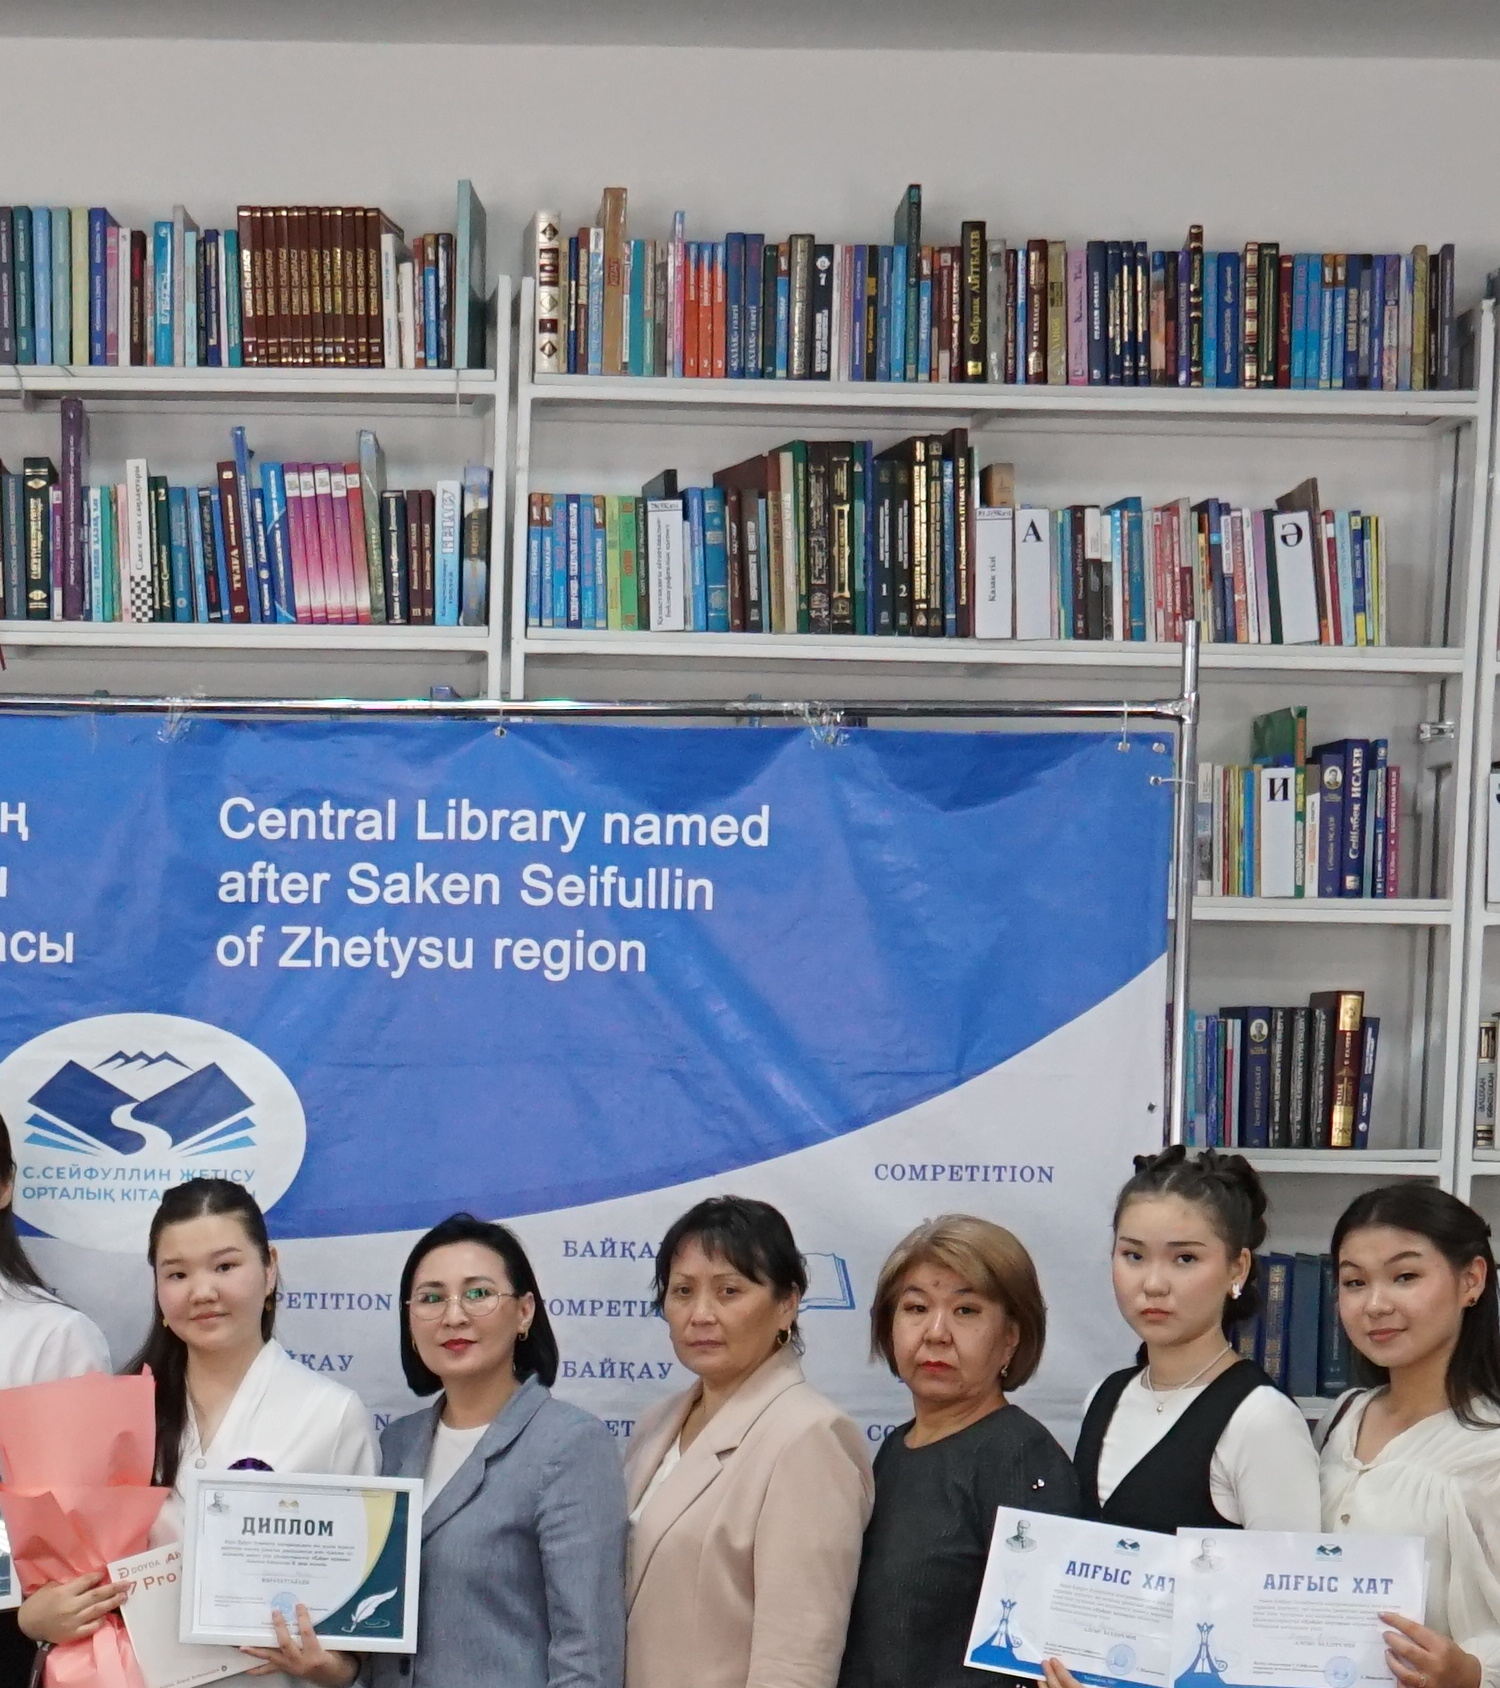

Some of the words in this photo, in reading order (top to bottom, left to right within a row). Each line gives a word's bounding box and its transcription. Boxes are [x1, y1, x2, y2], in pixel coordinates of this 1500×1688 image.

[898, 583, 908, 597] 2
[1349, 747, 1362, 798] ИСАЕВ
[219, 796, 397, 842] Central
[417, 798, 587, 854] Library
[603, 804, 770, 848] named
[218, 861, 332, 905] after
[347, 862, 501, 906] Saken
[520, 863, 714, 911] Seifullin
[216, 925, 266, 968] of
[278, 925, 474, 980] Zhetysu
[494, 929, 646, 982] region
[874, 1163, 1055, 1184] COMPETITION
[21, 1186, 116, 1203] ОРТАЛЫҚ
[562, 1236, 657, 1263] БАЙҚА
[274, 1291, 392, 1313] PETITION
[561, 1357, 673, 1382] БАЙҚАУ
[241, 1516, 334, 1537] ДИПЛОМ
[144, 1570, 178, 1592] Pro
[1065, 1560, 1133, 1586] АЛҒЫС
[1263, 1573, 1339, 1593] АЛҒЫС
[1352, 1577, 1394, 1595] ХАТ
